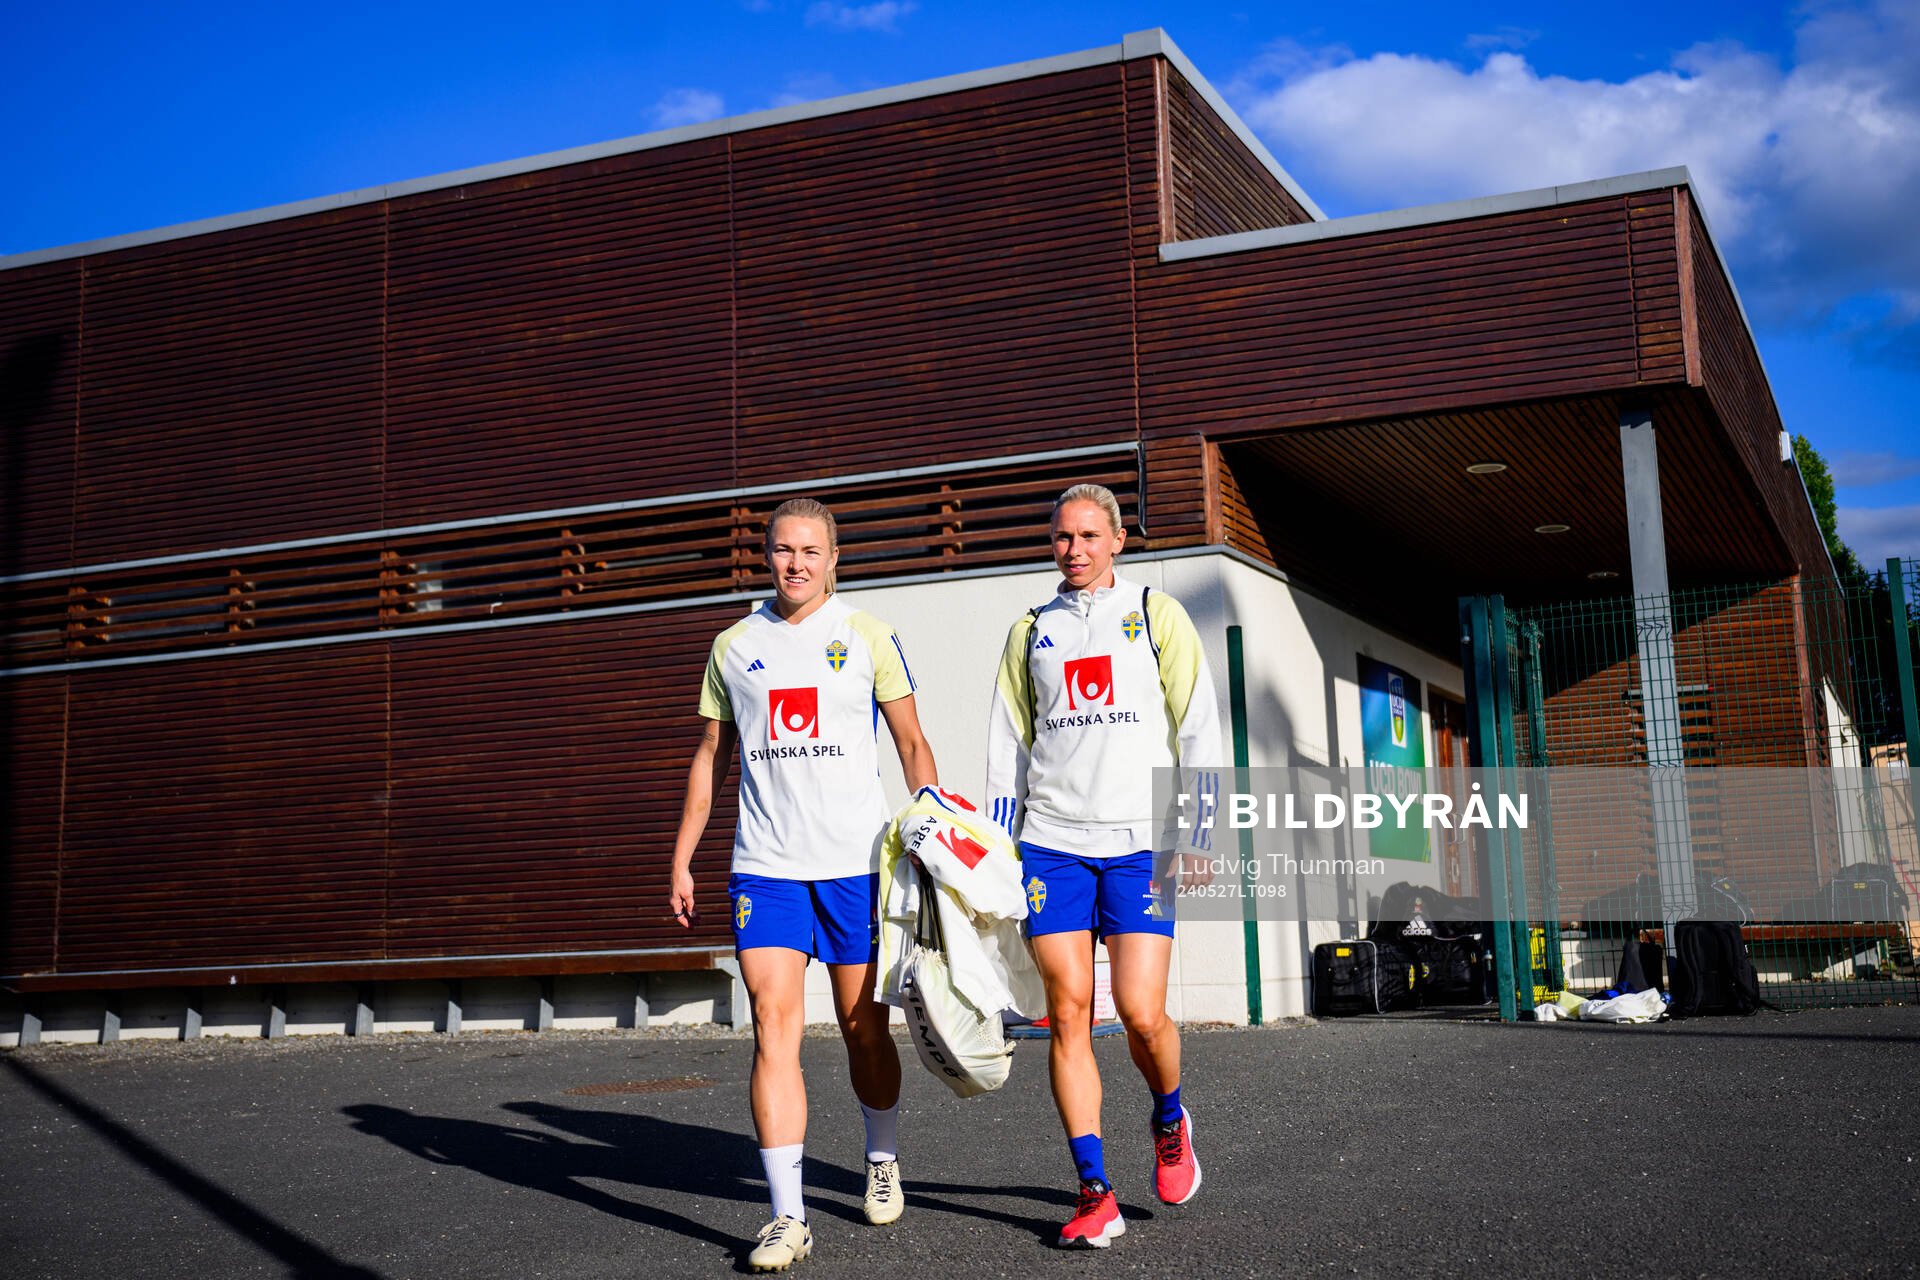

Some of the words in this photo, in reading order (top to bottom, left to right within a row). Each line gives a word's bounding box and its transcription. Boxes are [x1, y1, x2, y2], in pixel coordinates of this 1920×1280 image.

[1045, 713, 1103, 730] SVENSKA
[1108, 712, 1140, 724] SPEL
[750, 746, 808, 762] SVENSKA
[812, 745, 845, 757] SPEL
[1369, 759, 1395, 797] UCD
[1402, 927, 1432, 936] adidas
